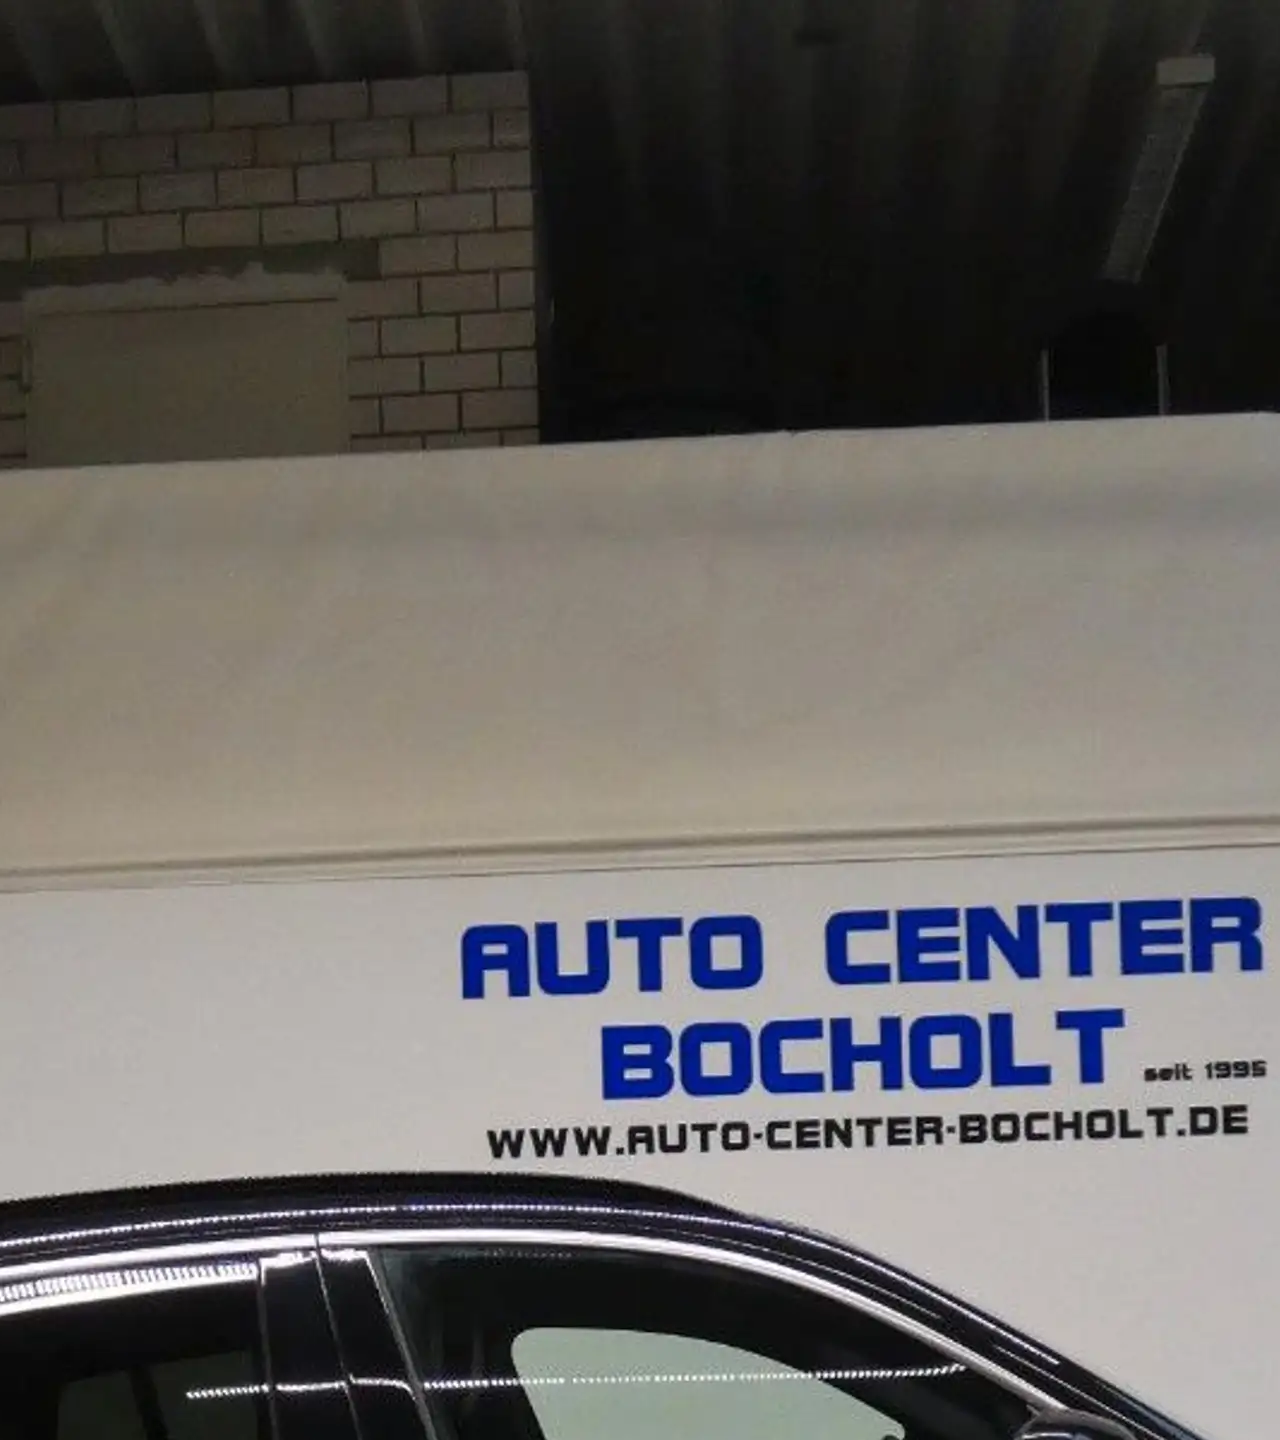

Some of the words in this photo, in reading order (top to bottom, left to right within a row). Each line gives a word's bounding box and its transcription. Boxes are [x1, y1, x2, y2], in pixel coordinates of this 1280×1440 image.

[462, 914, 764, 999] AUTO
[826, 897, 1262, 985] CENTER
[601, 1008, 1125, 1101] BOCHOLT
[1143, 1062, 1194, 1082] seit
[1204, 1060, 1267, 1080] 1995
[486, 1104, 1249, 1159] WWW.AUTO-CENTER-BOCHOLT.DE
